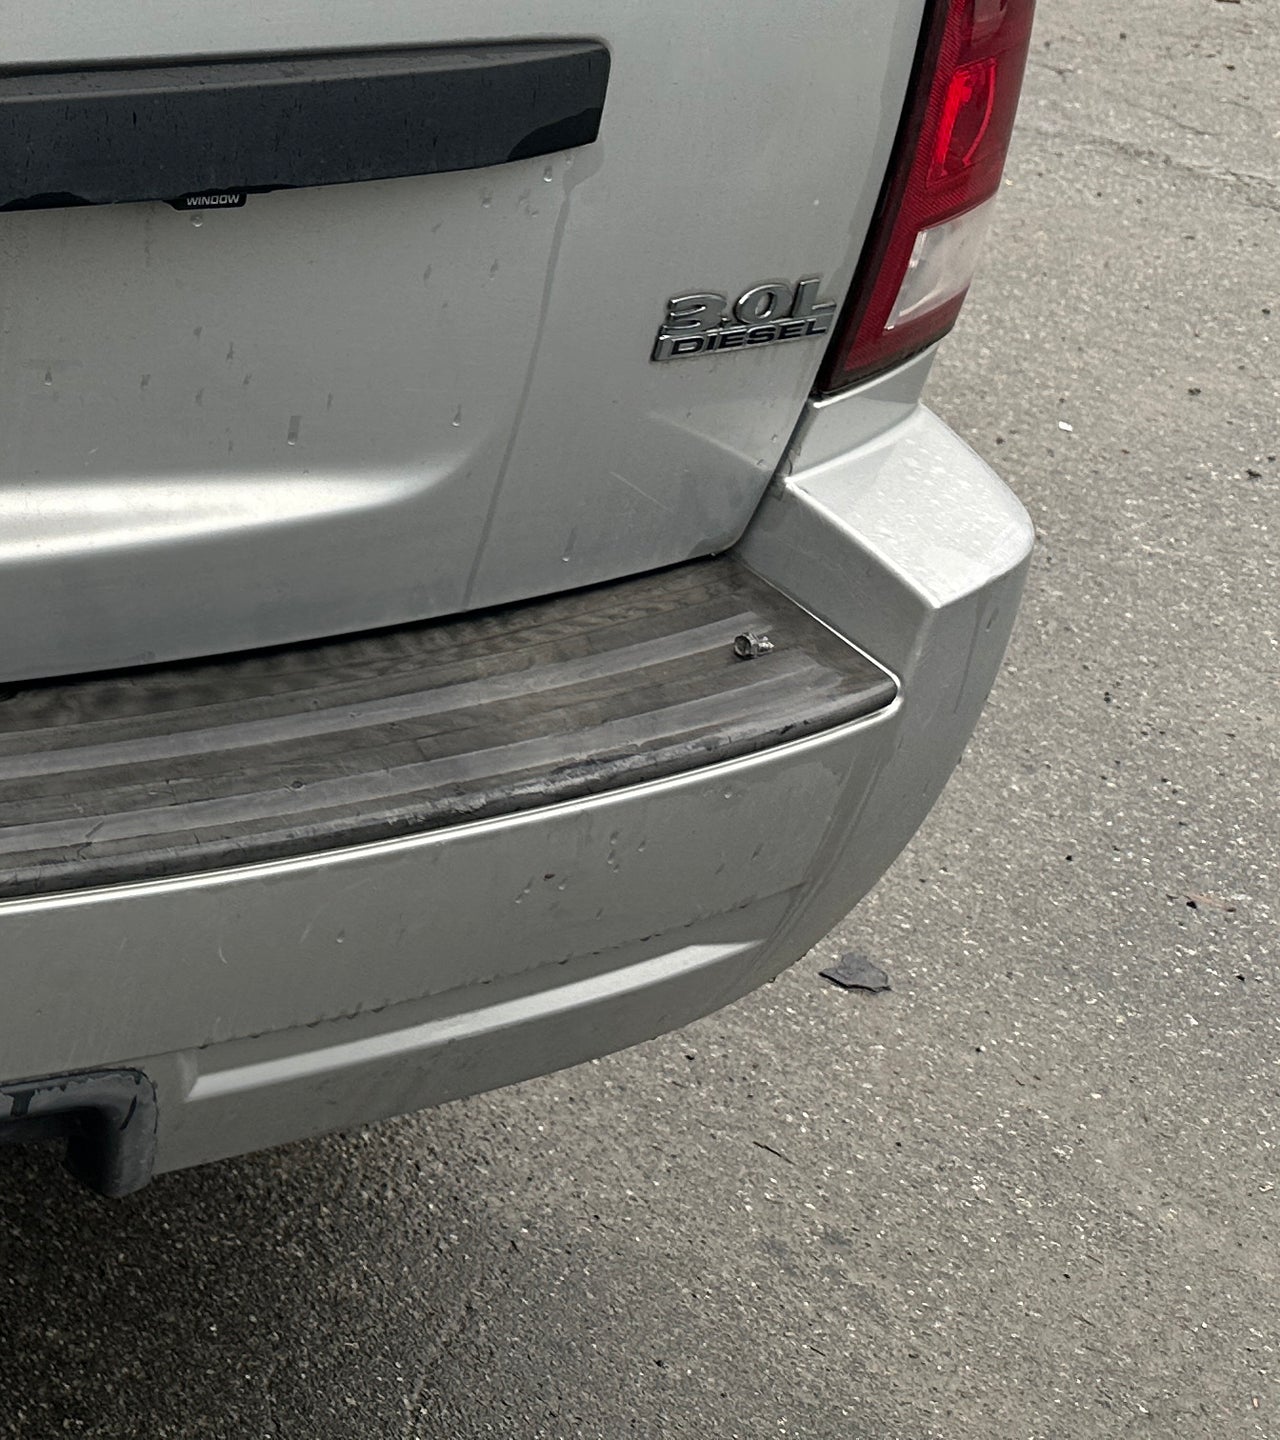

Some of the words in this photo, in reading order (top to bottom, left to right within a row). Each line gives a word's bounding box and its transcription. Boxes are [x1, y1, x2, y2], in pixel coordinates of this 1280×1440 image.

[186, 194, 240, 206] WINDOW
[659, 278, 837, 332] 3.0L
[670, 317, 827, 356] DIESEL
